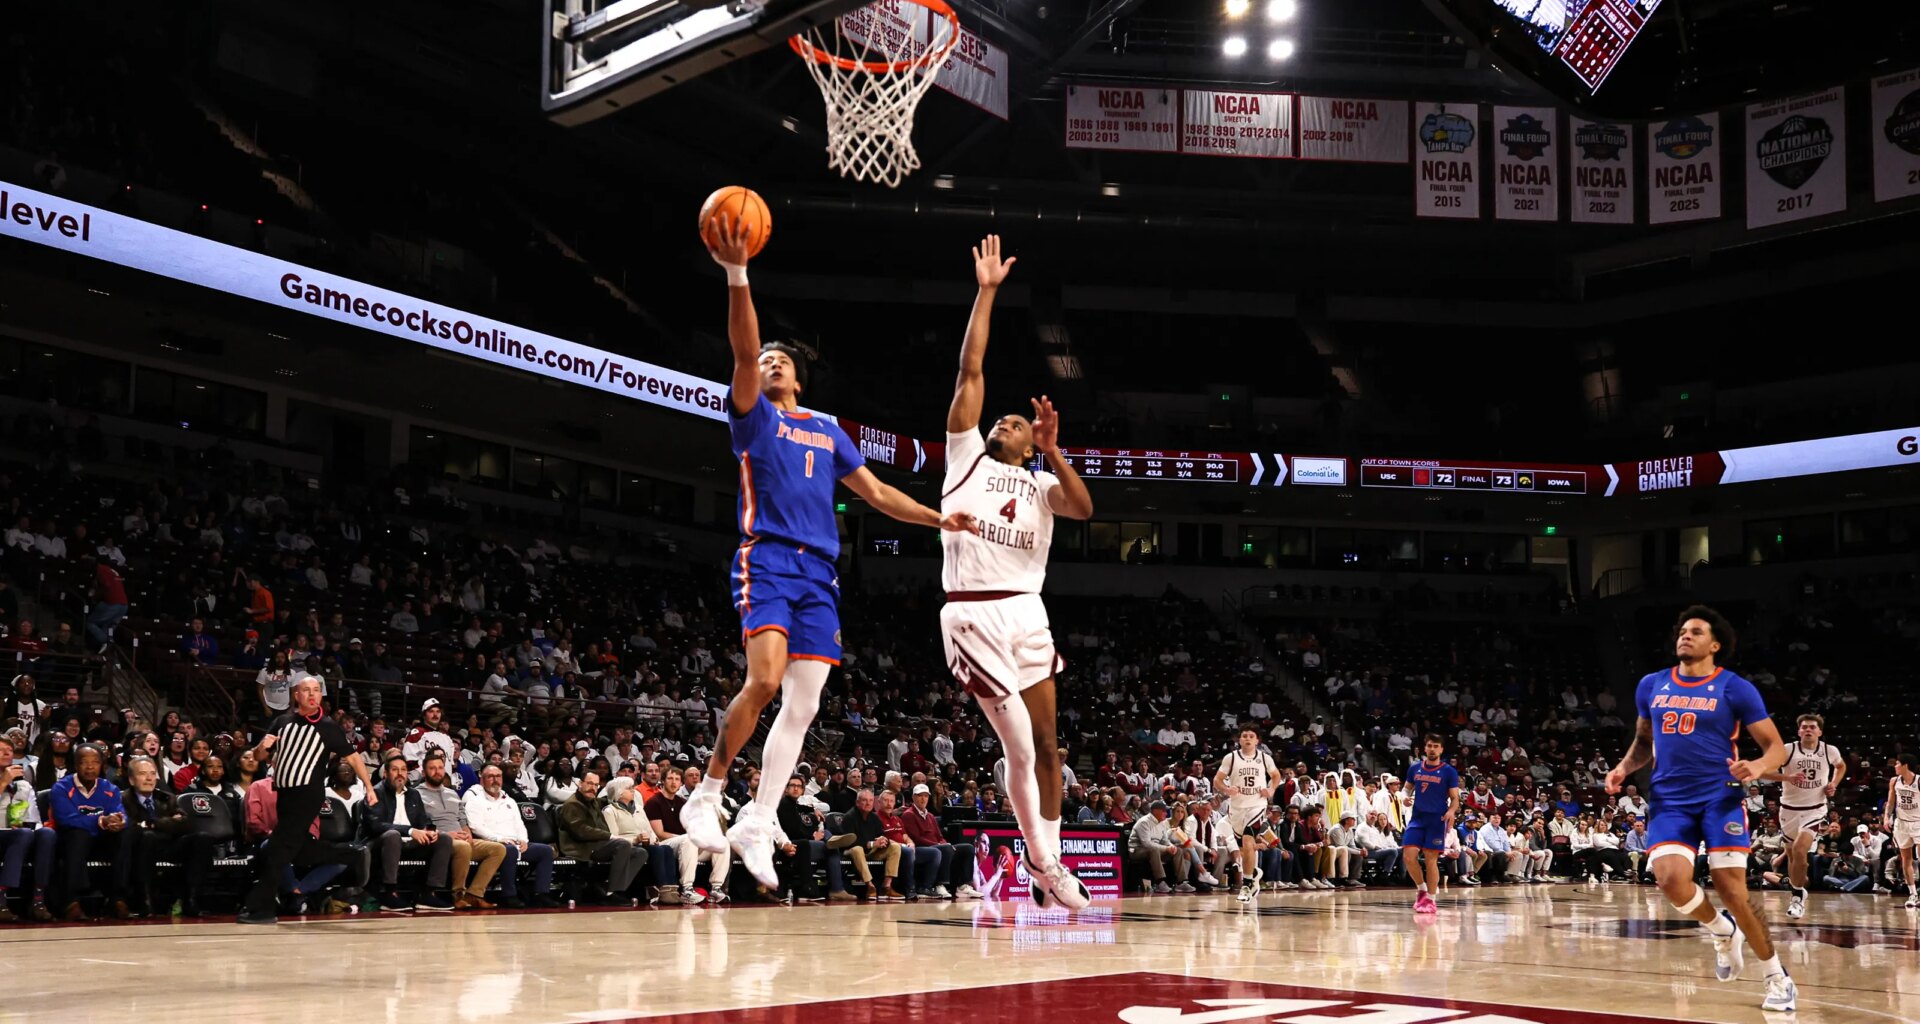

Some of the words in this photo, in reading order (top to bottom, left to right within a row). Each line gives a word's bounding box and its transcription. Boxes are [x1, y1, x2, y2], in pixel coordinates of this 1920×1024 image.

[845, 18, 865, 37] 2020
[961, 33, 982, 61] SEC
[1099, 90, 1145, 109] NCAA
[1215, 95, 1260, 115] NCAA
[1331, 101, 1378, 120] NCAA
[1069, 119, 1093, 129] 1986
[1152, 123, 1174, 133] 1991
[1185, 124, 1209, 135] 1982
[1212, 126, 1235, 136] 1990
[1240, 128, 1264, 138] 2012
[1266, 129, 1290, 139] 2014
[1069, 131, 1093, 141] 2003
[1095, 132, 1119, 142] 2013
[1185, 137, 1209, 147] 2016
[1212, 139, 1236, 149] 2019
[1303, 131, 1326, 140] 2002
[1329, 131, 1353, 142] 2018
[1503, 133, 1525, 143] FINAL
[1526, 133, 1549, 143] FOUR
[1576, 134, 1600, 143] FINAL
[1602, 135, 1626, 145] FOUR
[1657, 133, 1683, 146] FINAL
[1685, 131, 1710, 142] FOUR
[1761, 129, 1829, 154] NATIONAL
[1427, 142, 1451, 152] TAMPA
[1451, 143, 1465, 153] BAY
[1764, 145, 1827, 167] CHAMPIONS
[1422, 160, 1472, 182] NCAA
[1500, 164, 1551, 185] NCAA
[1576, 167, 1627, 188] NCAA
[1655, 162, 1713, 188] NCAA
[1449, 184, 1465, 192] FOUR
[1508, 187, 1526, 195] FINAL
[1527, 188, 1544, 196] FOUR
[1603, 190, 1620, 198] FOUR
[1664, 189, 1684, 197] FINAL
[1686, 186, 1705, 195] FOUR
[1434, 196, 1461, 208] 2015
[1514, 199, 1540, 210] 2021
[1589, 202, 1615, 213] 2023
[1670, 199, 1700, 212] 2025
[1777, 194, 1813, 213] 2017
[0, 191, 90, 241] level
[776, 421, 834, 454] FLORIDA
[860, 425, 897, 446] FOREVER
[860, 439, 896, 465] GARNET
[805, 450, 814, 478] 1
[1115, 459, 1132, 467] 2/15
[1638, 456, 1693, 475] FOREVER
[1115, 468, 1132, 476] 7/16
[1177, 470, 1191, 478] 3/4
[1297, 469, 1325, 477] Colonial
[1327, 469, 1339, 478] Life
[1436, 473, 1452, 483] 72
[1462, 475, 1486, 483] FINAL
[1496, 476, 1512, 485] 73
[1638, 469, 1693, 492] GARNET
[986, 476, 1037, 506] SOUTH
[1000, 498, 1017, 524] 4
[978, 519, 1035, 550] AROLINA
[1650, 694, 1718, 712] FLORIDA
[1661, 711, 1697, 735] 20
[1797, 759, 1821, 770] SOUTH
[1238, 768, 1260, 777] SOUTH
[1243, 776, 1255, 787] 15
[1421, 782, 1429, 793] 7
[1897, 789, 1916, 797] SOUTH
[1897, 803, 1918, 811] CAROLINA
[1063, 840, 1096, 854] FINANCIAL
[1097, 840, 1117, 854] GAME!
